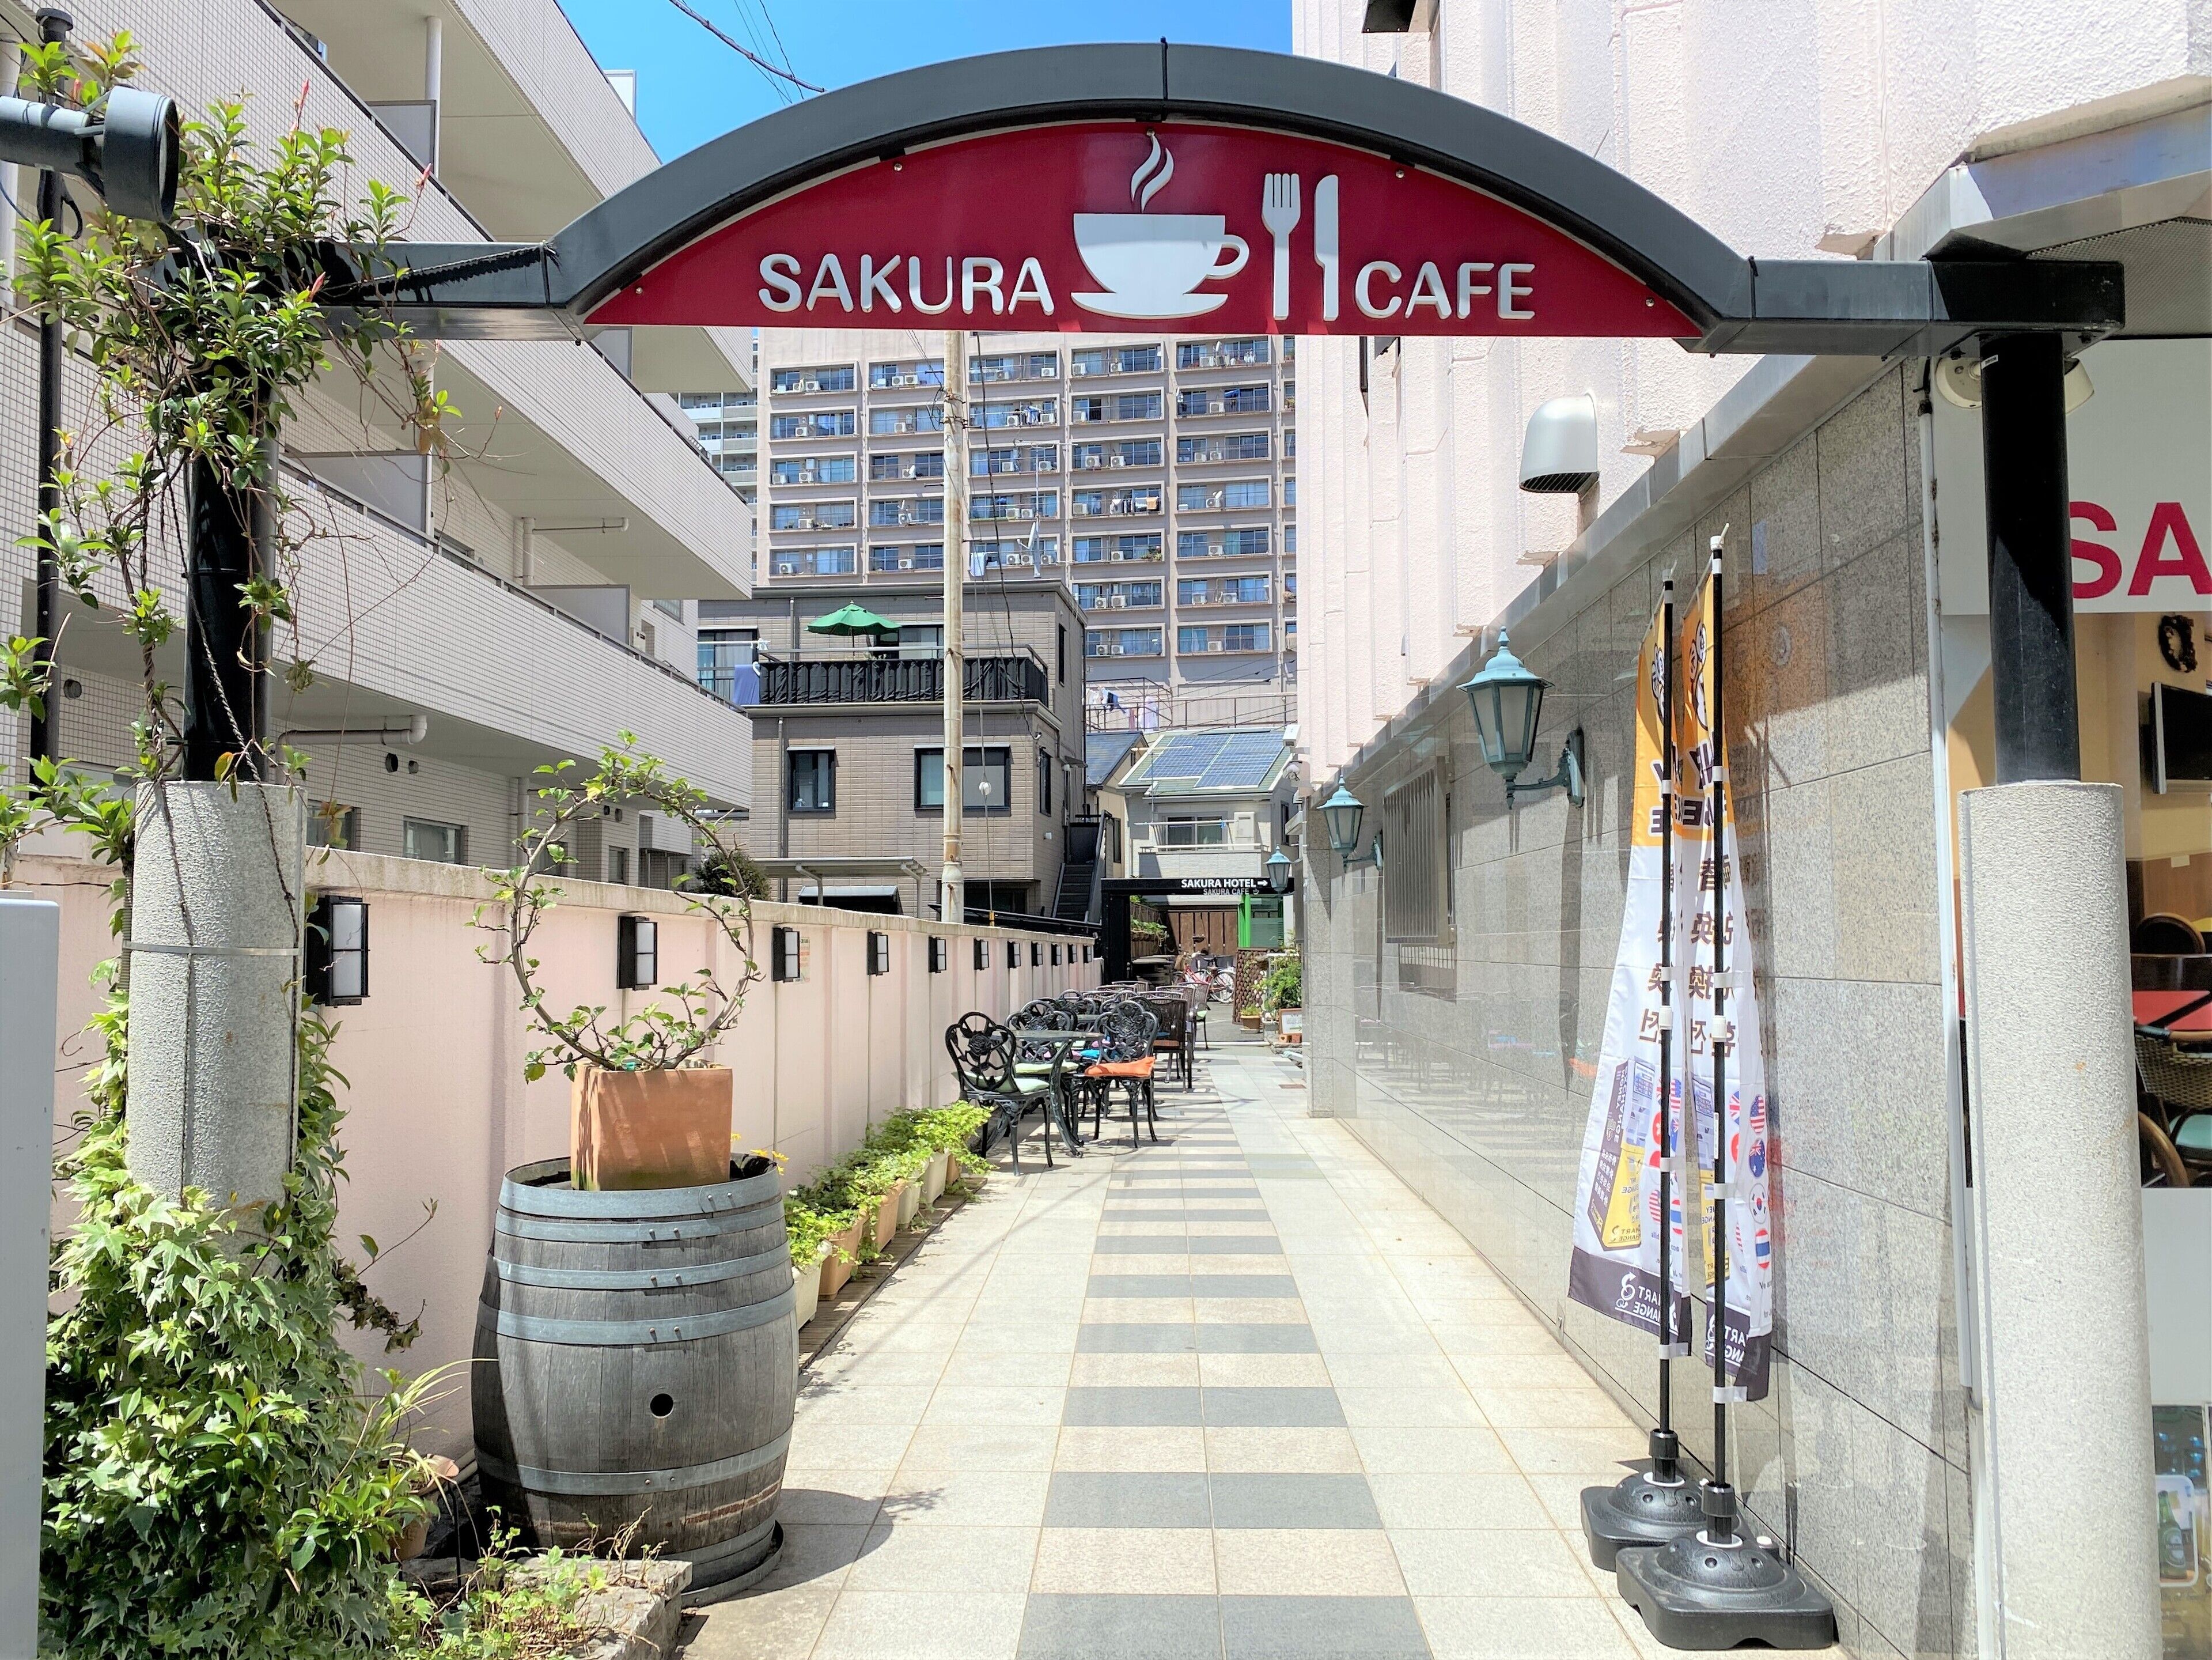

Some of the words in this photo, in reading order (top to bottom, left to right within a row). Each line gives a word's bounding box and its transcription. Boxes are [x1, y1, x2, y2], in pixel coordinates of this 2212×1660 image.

[757, 252, 1055, 316] SAKURA
[1354, 260, 1536, 320] CAFE
[2069, 500, 2212, 599] SA
[1181, 878, 1222, 888] SAKURA
[1224, 878, 1256, 888] HOTEL
